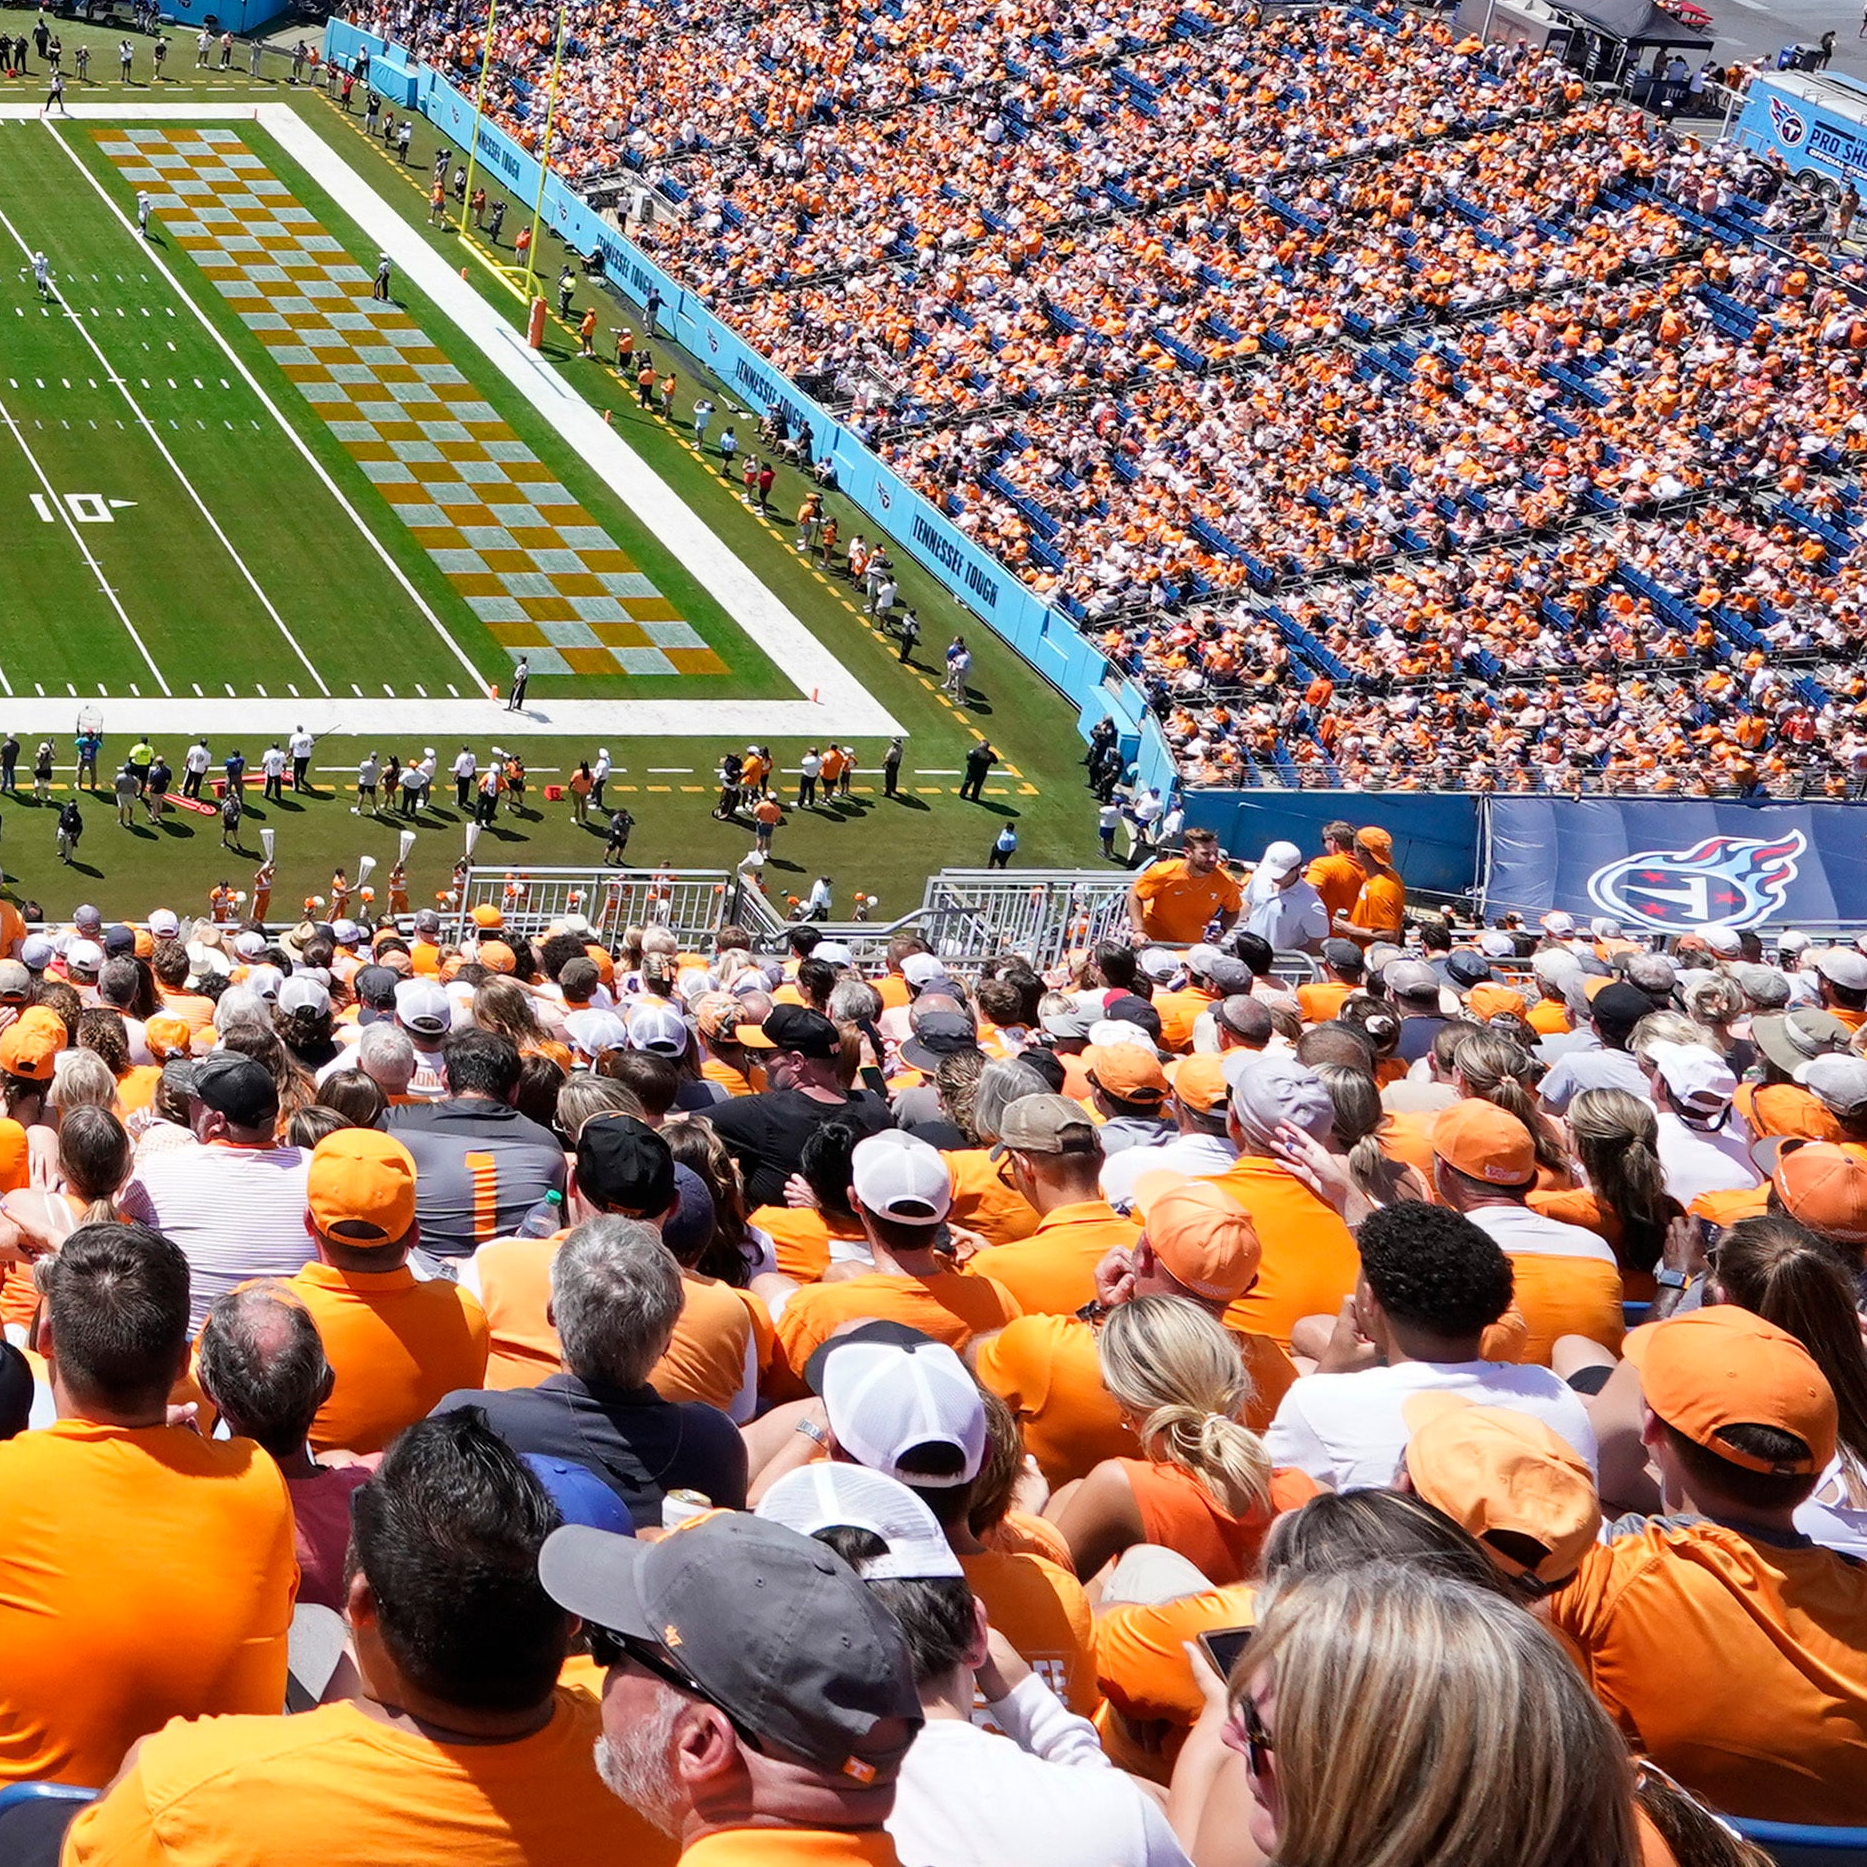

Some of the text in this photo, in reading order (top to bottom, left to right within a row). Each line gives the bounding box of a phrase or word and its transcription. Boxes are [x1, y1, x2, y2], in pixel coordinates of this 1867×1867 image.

[1808, 127, 1841, 154] PRO
[30, 491, 115, 523] 10
[912, 514, 1000, 609] TENNESSEE TOUGH
